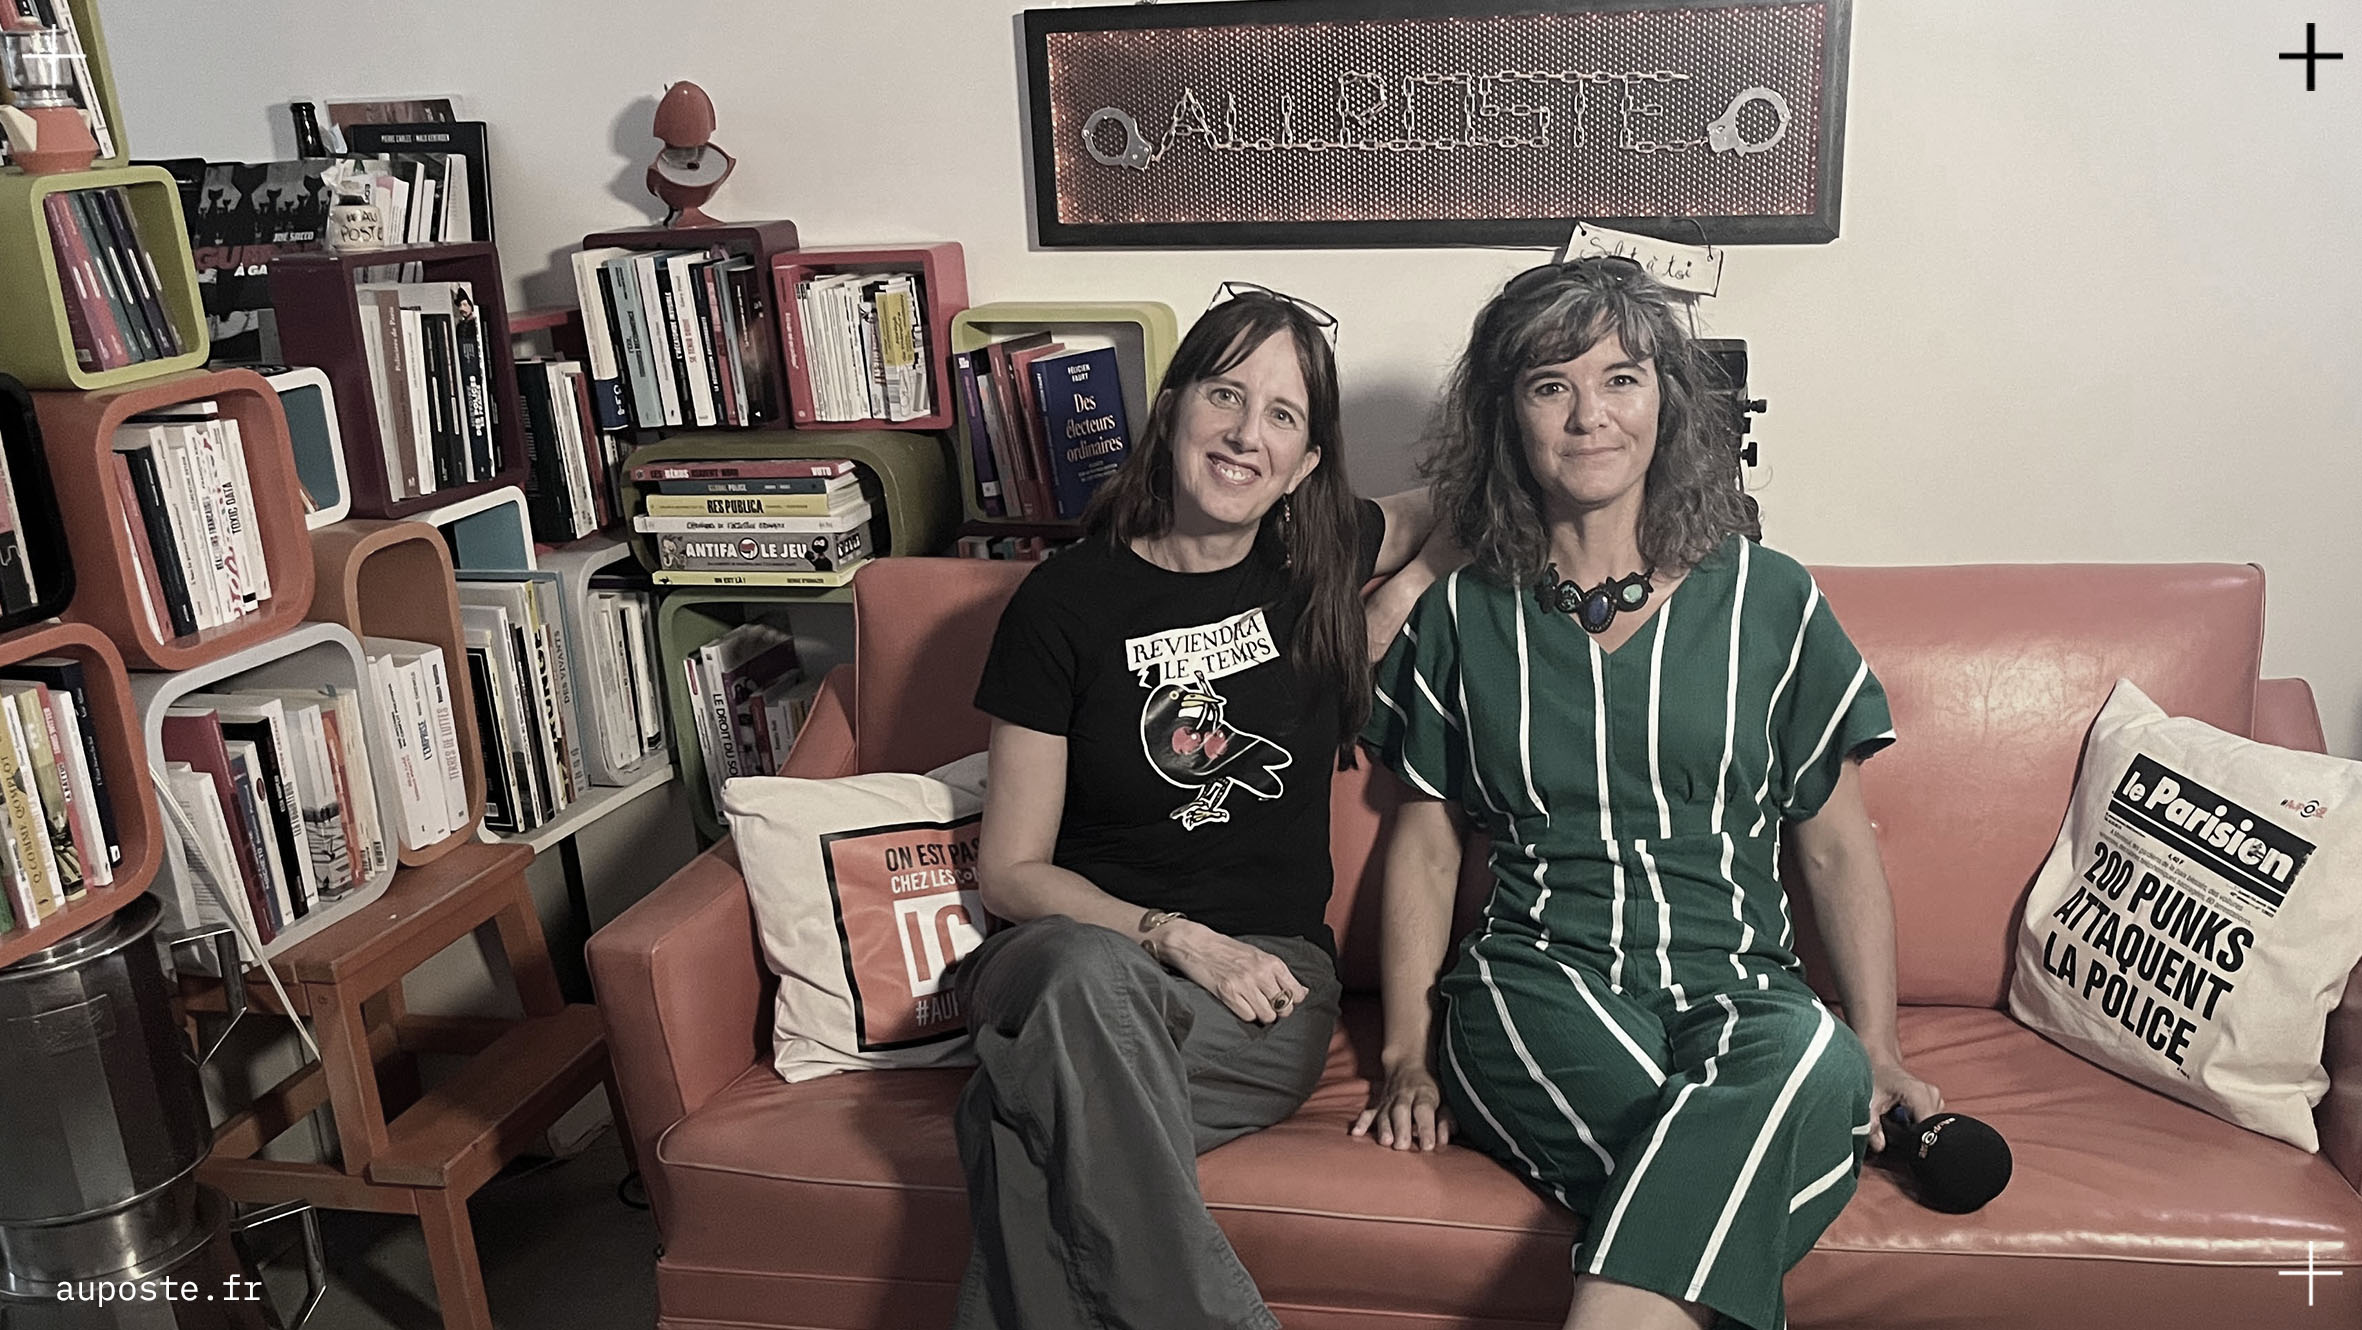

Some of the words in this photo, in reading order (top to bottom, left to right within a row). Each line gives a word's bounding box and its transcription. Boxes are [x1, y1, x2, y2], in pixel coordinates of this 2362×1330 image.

[290, 231, 315, 241] SACCO
[1663, 255, 1692, 279] toi
[1067, 364, 1090, 375] FÉLICIEN
[1072, 373, 1089, 382] FAURY
[1074, 393, 1096, 413] Des
[1066, 414, 1116, 439] électeurs
[1067, 436, 1124, 463] ordinaires
[221, 481, 236, 505] DATA
[707, 500, 724, 513] RES
[726, 500, 764, 513] PUBLICA
[227, 506, 242, 535] TOXIC
[686, 543, 737, 558] ANTIFA
[762, 545, 779, 558] LE
[781, 543, 807, 558] JEU
[553, 629, 568, 681] VIVANTS
[1164, 660, 1190, 680] LE
[1201, 637, 1271, 674] TEMPS
[559, 681, 571, 703] DES
[711, 692, 724, 707] LE
[435, 705, 453, 736] LUTTES
[713, 706, 732, 742] DROIT
[442, 737, 454, 749] DE
[722, 740, 736, 759] DU
[443, 749, 459, 780] TERRES
[726, 758, 739, 778] SO
[0, 754, 27, 820] QOMPLOT
[2122, 772, 2146, 802] le
[2148, 775, 2295, 884] Parisien
[17, 821, 40, 871] COMME
[884, 847, 913, 872] ON
[917, 844, 947, 868] EST
[948, 837, 980, 865] PAS
[32, 871, 44, 884] Q
[890, 872, 929, 894] CHEZ
[930, 868, 956, 888] LES
[2083, 841, 2135, 901] 200
[2127, 872, 2255, 973] PUNKS
[2052, 888, 2234, 1022] ATTAQUENT
[2043, 931, 2078, 991] LA
[2083, 959, 2198, 1066] POLICE
